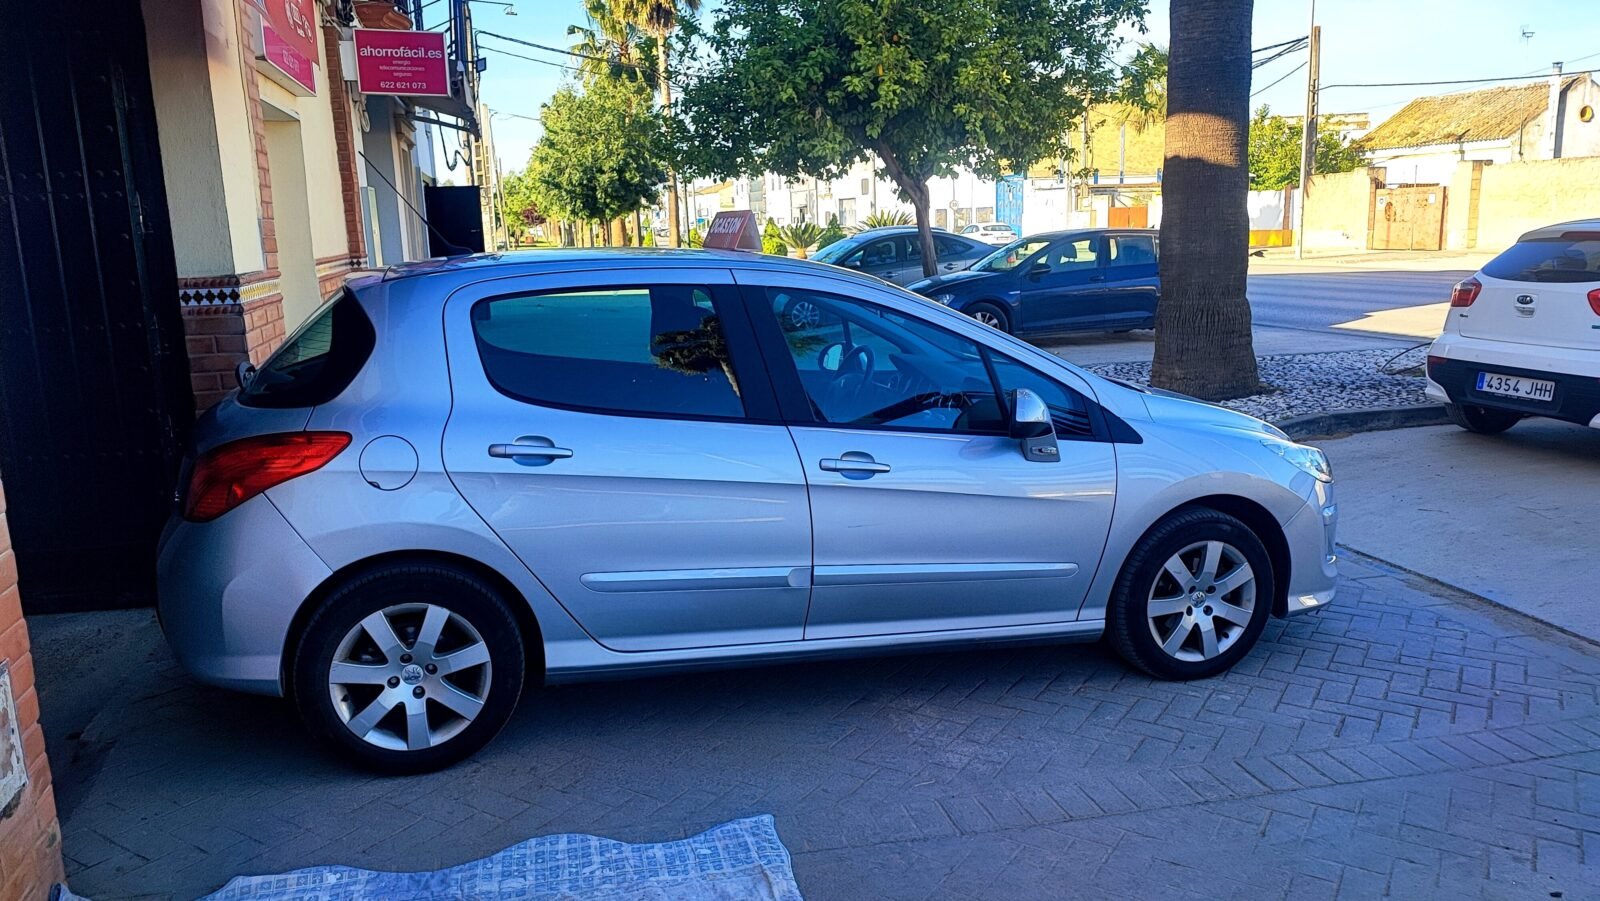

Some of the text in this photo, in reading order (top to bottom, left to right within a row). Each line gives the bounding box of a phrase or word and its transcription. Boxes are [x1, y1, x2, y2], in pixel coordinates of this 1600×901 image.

[360, 46, 442, 58] ahorrofácil.es
[380, 81, 395, 89] 622
[1486, 376, 1520, 393] 4354
[1525, 381, 1553, 398] JHH
